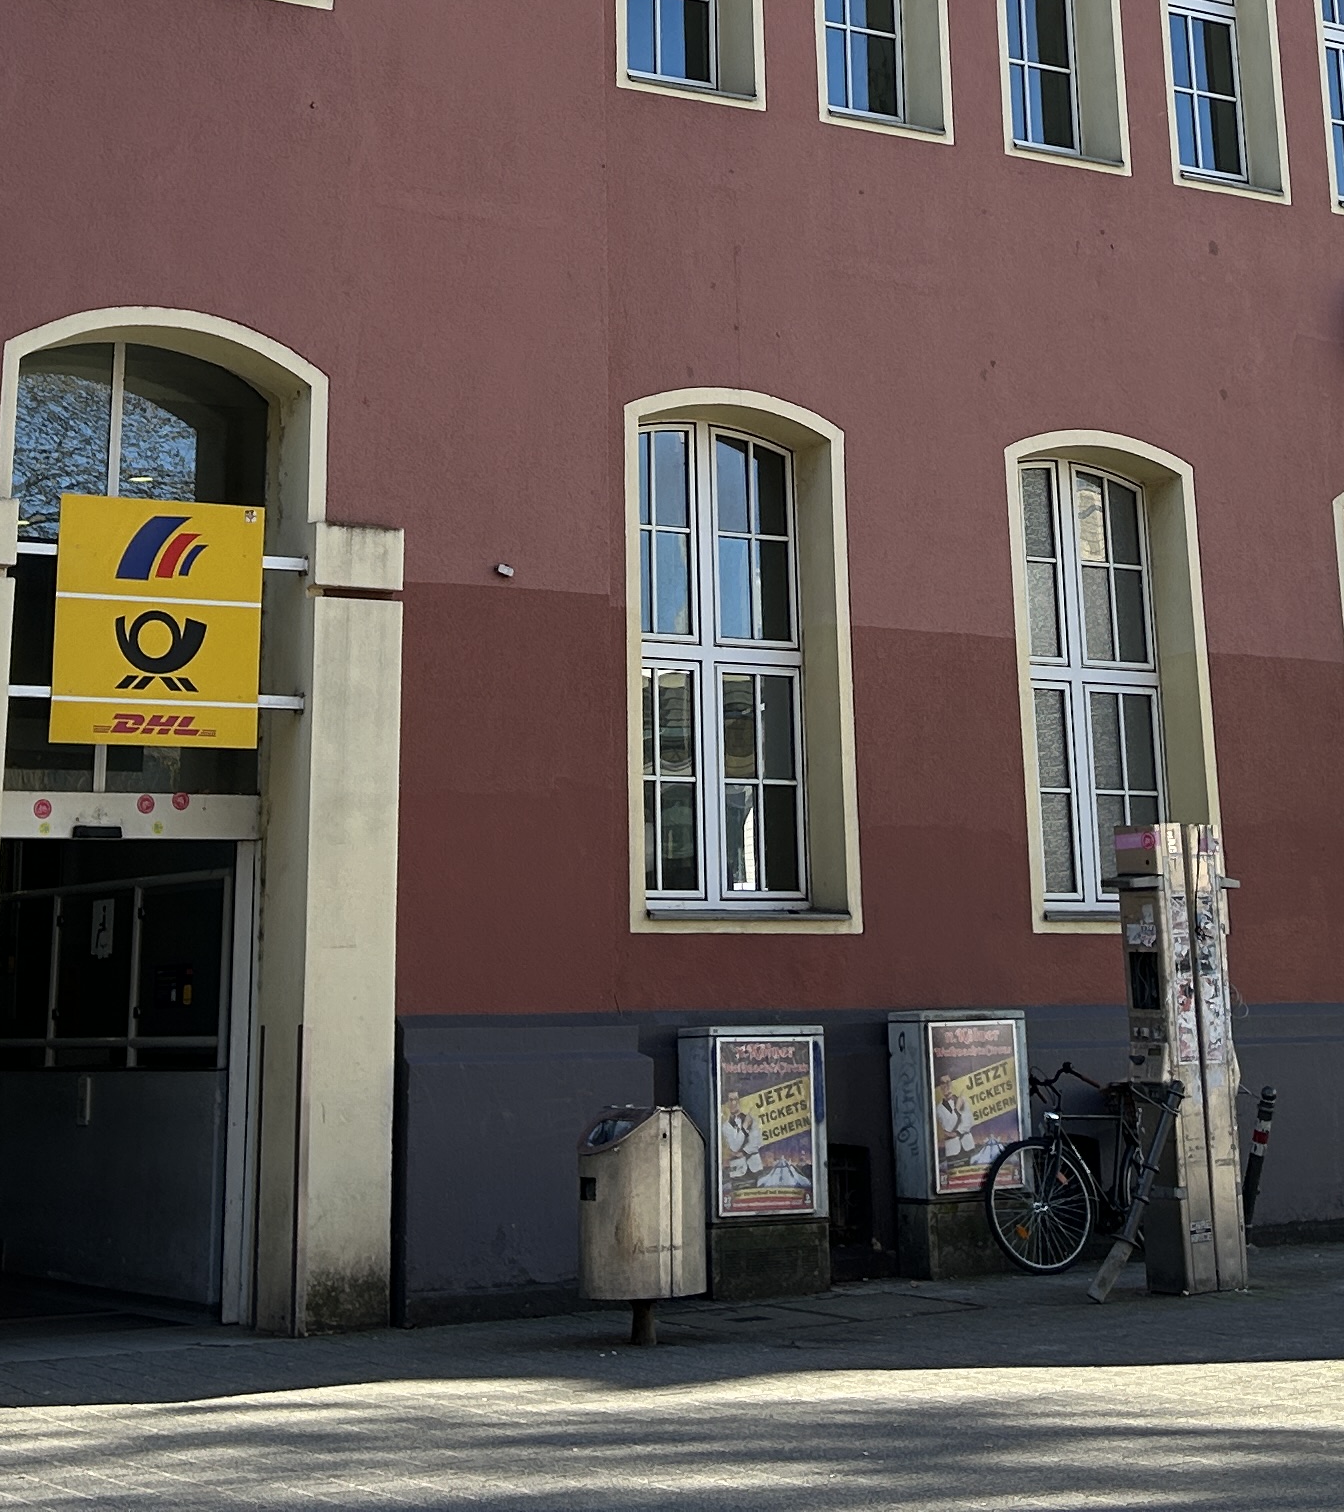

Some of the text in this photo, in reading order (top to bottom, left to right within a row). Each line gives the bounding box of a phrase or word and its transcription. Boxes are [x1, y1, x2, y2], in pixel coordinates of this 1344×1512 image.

[110, 712, 196, 736] DHL
[966, 1063, 1008, 1090] JETZT
[755, 1079, 804, 1110] JETZT
[970, 1080, 1012, 1106] TICKETS
[758, 1099, 808, 1126] TICKETS
[973, 1096, 1016, 1122] SICHERN
[761, 1115, 812, 1142] SICHERN
